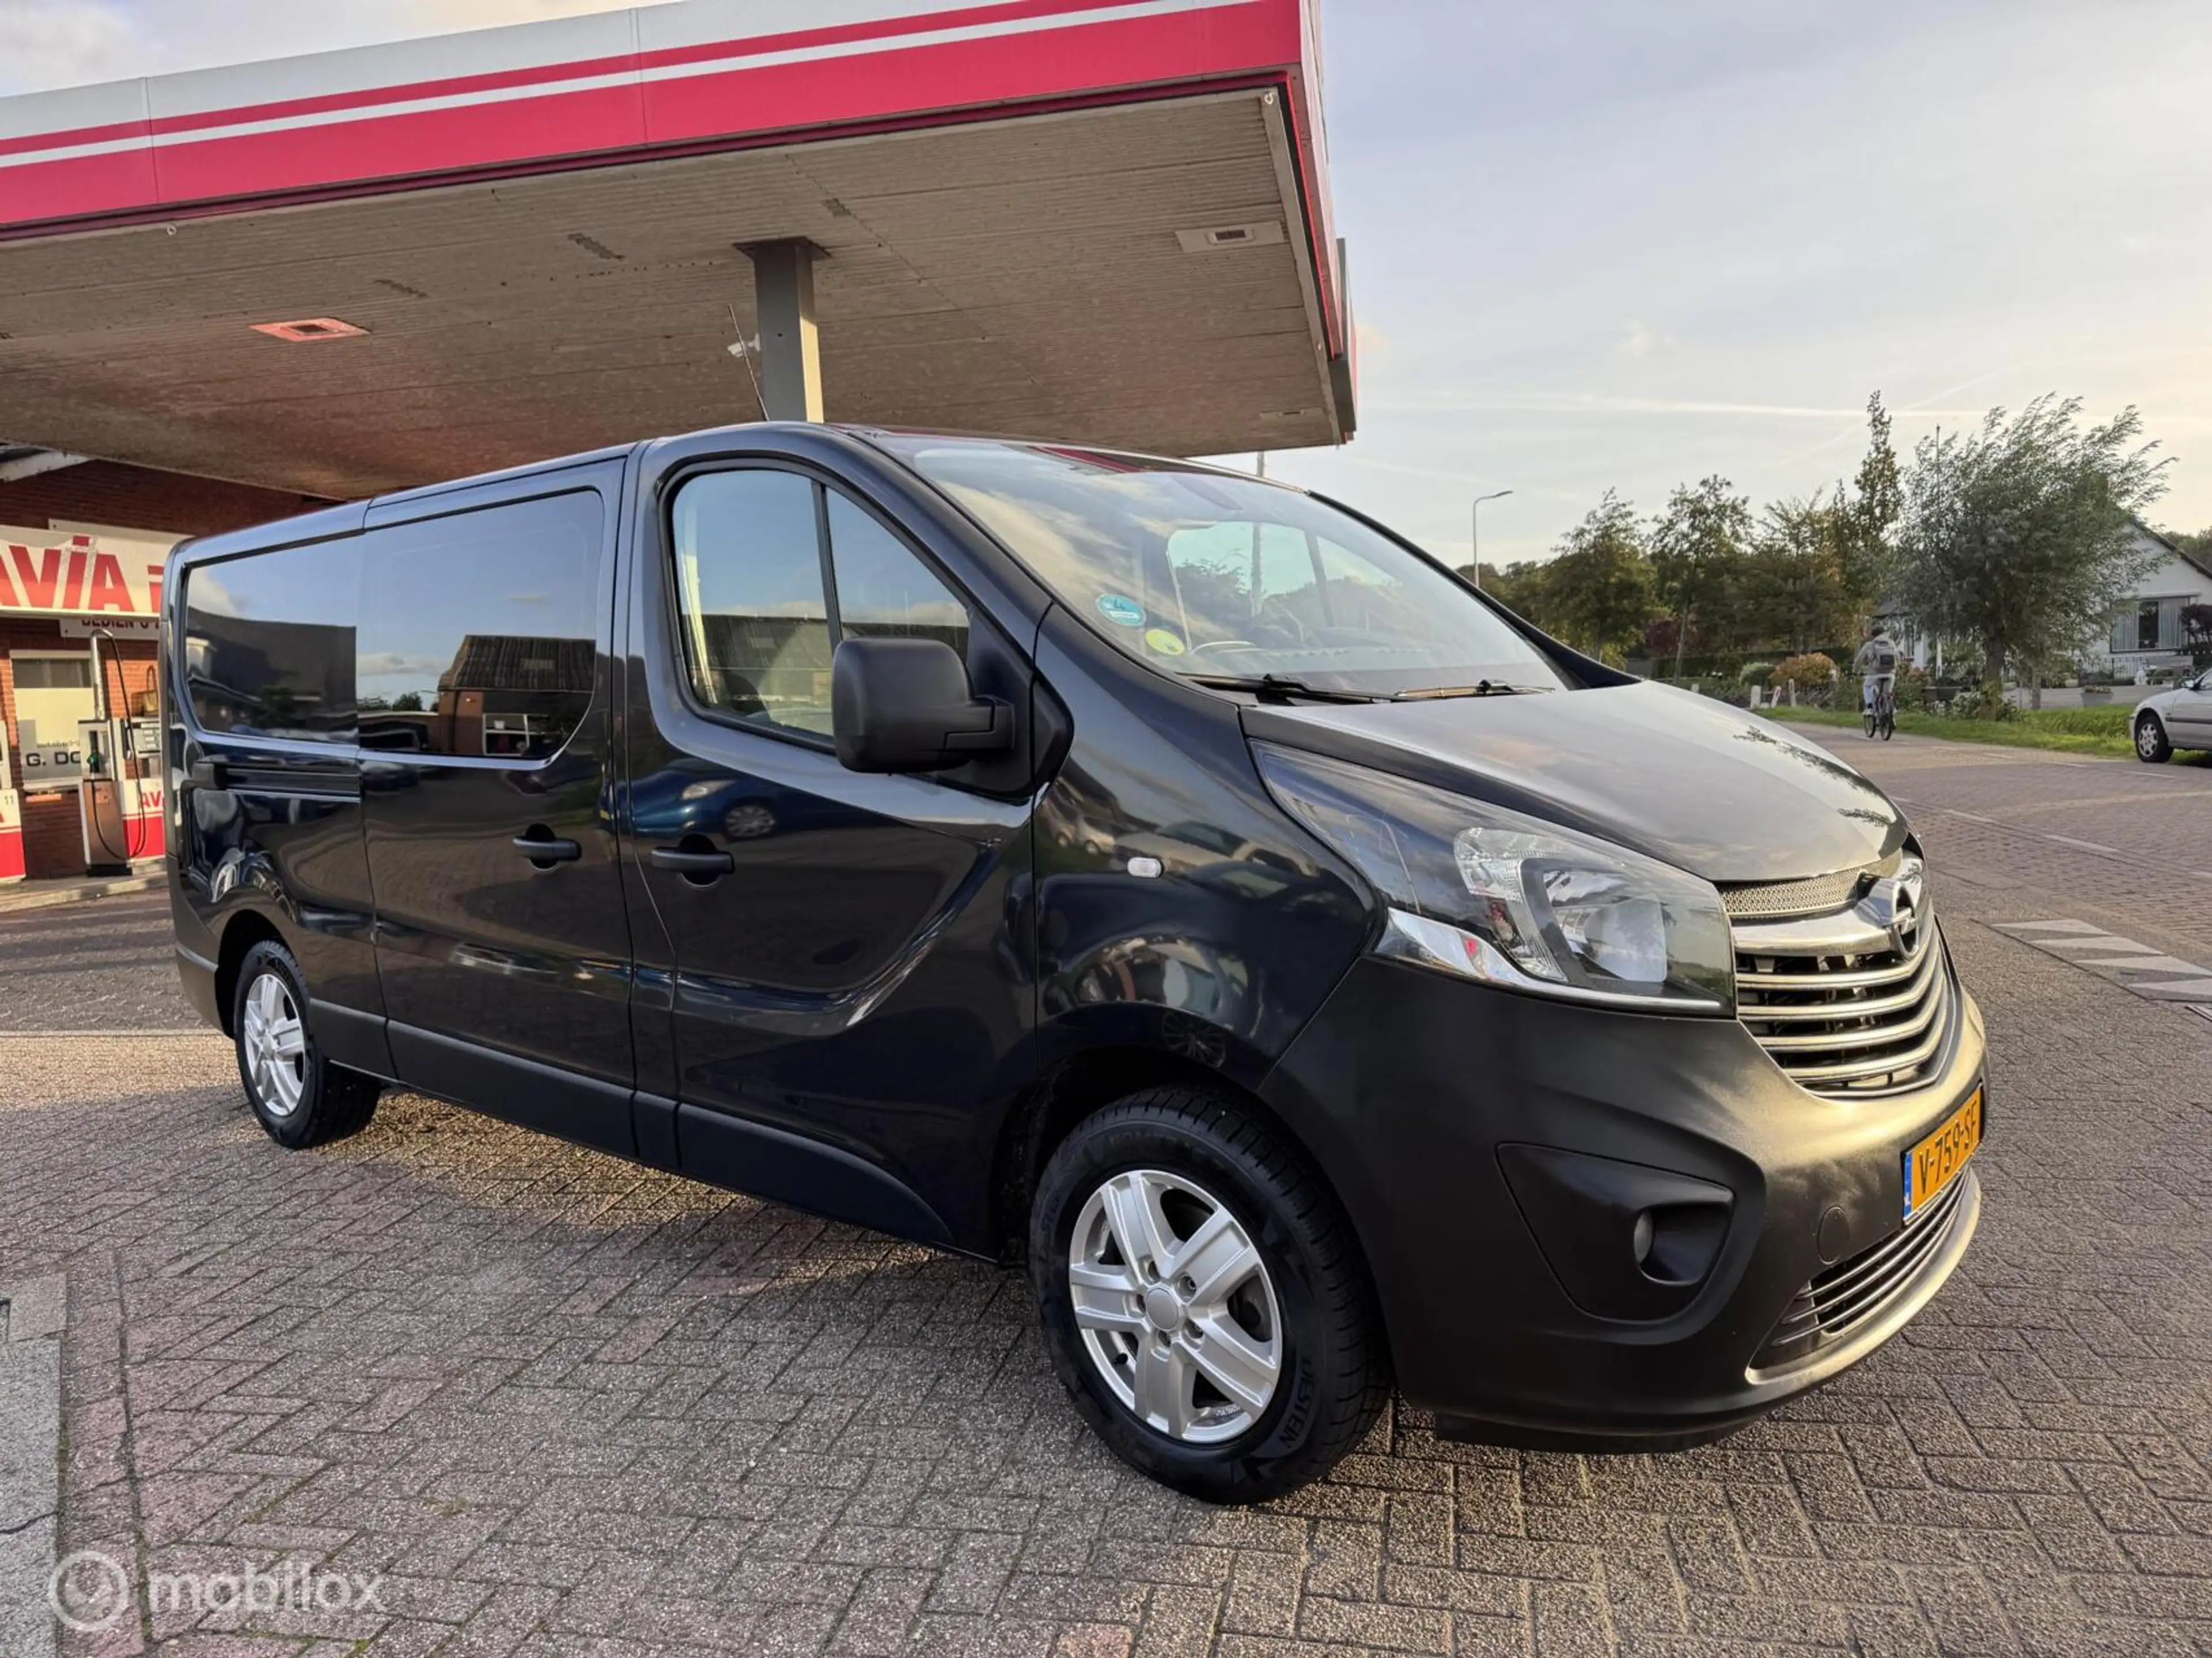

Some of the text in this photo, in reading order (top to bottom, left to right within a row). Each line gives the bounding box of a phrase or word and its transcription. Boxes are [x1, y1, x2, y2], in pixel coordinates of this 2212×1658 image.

[26, 753, 47, 767] G.
[138, 790, 165, 809] AV
[1919, 1099, 1977, 1194] V-759-SF
